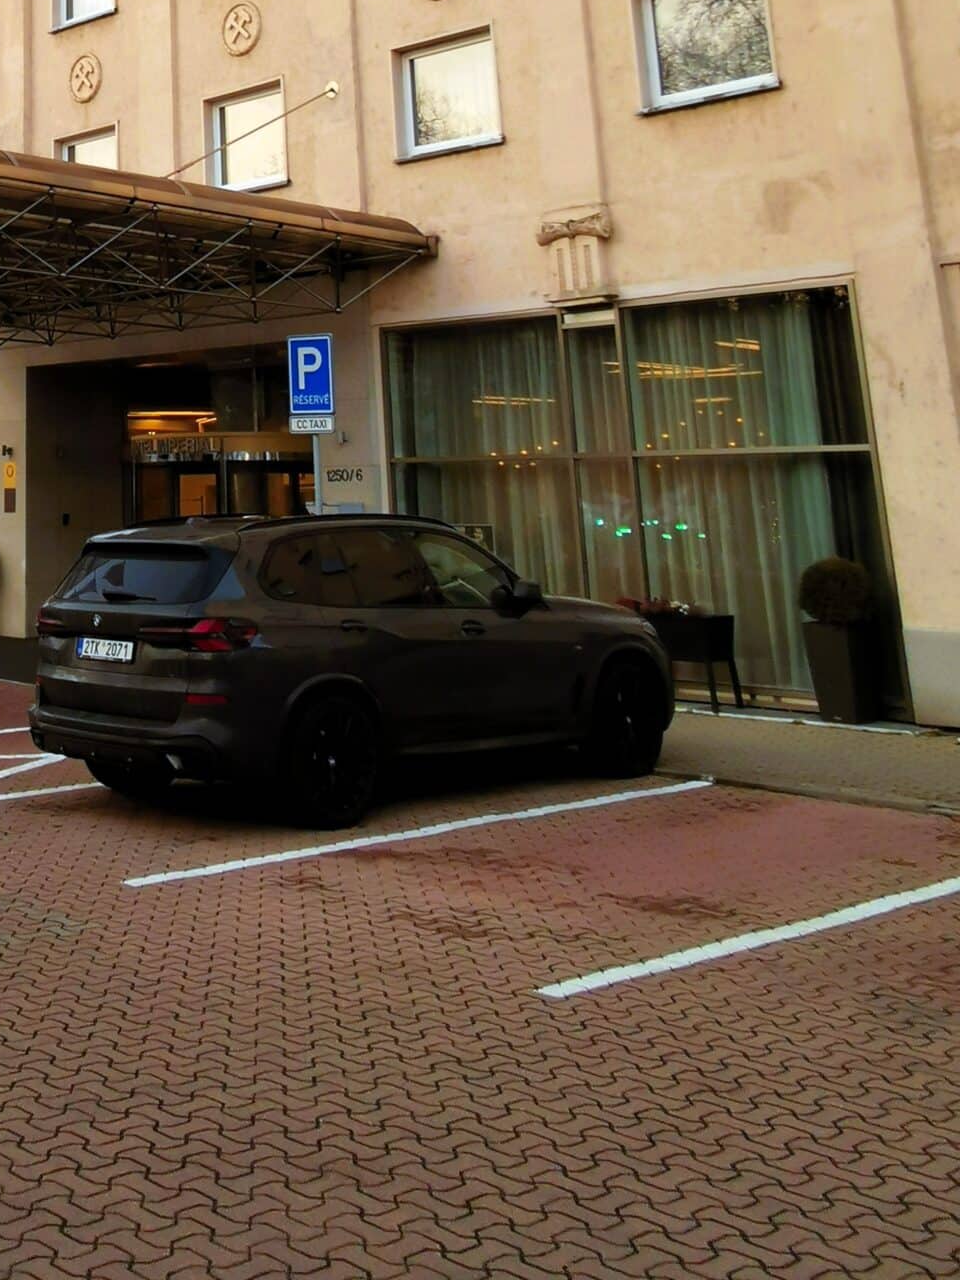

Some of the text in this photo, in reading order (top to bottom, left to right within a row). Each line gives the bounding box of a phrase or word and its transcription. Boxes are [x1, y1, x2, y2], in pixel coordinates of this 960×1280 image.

[297, 347, 322, 390] P
[296, 419, 327, 429] CC TAXI
[84, 640, 128, 658] 2TK 2071
